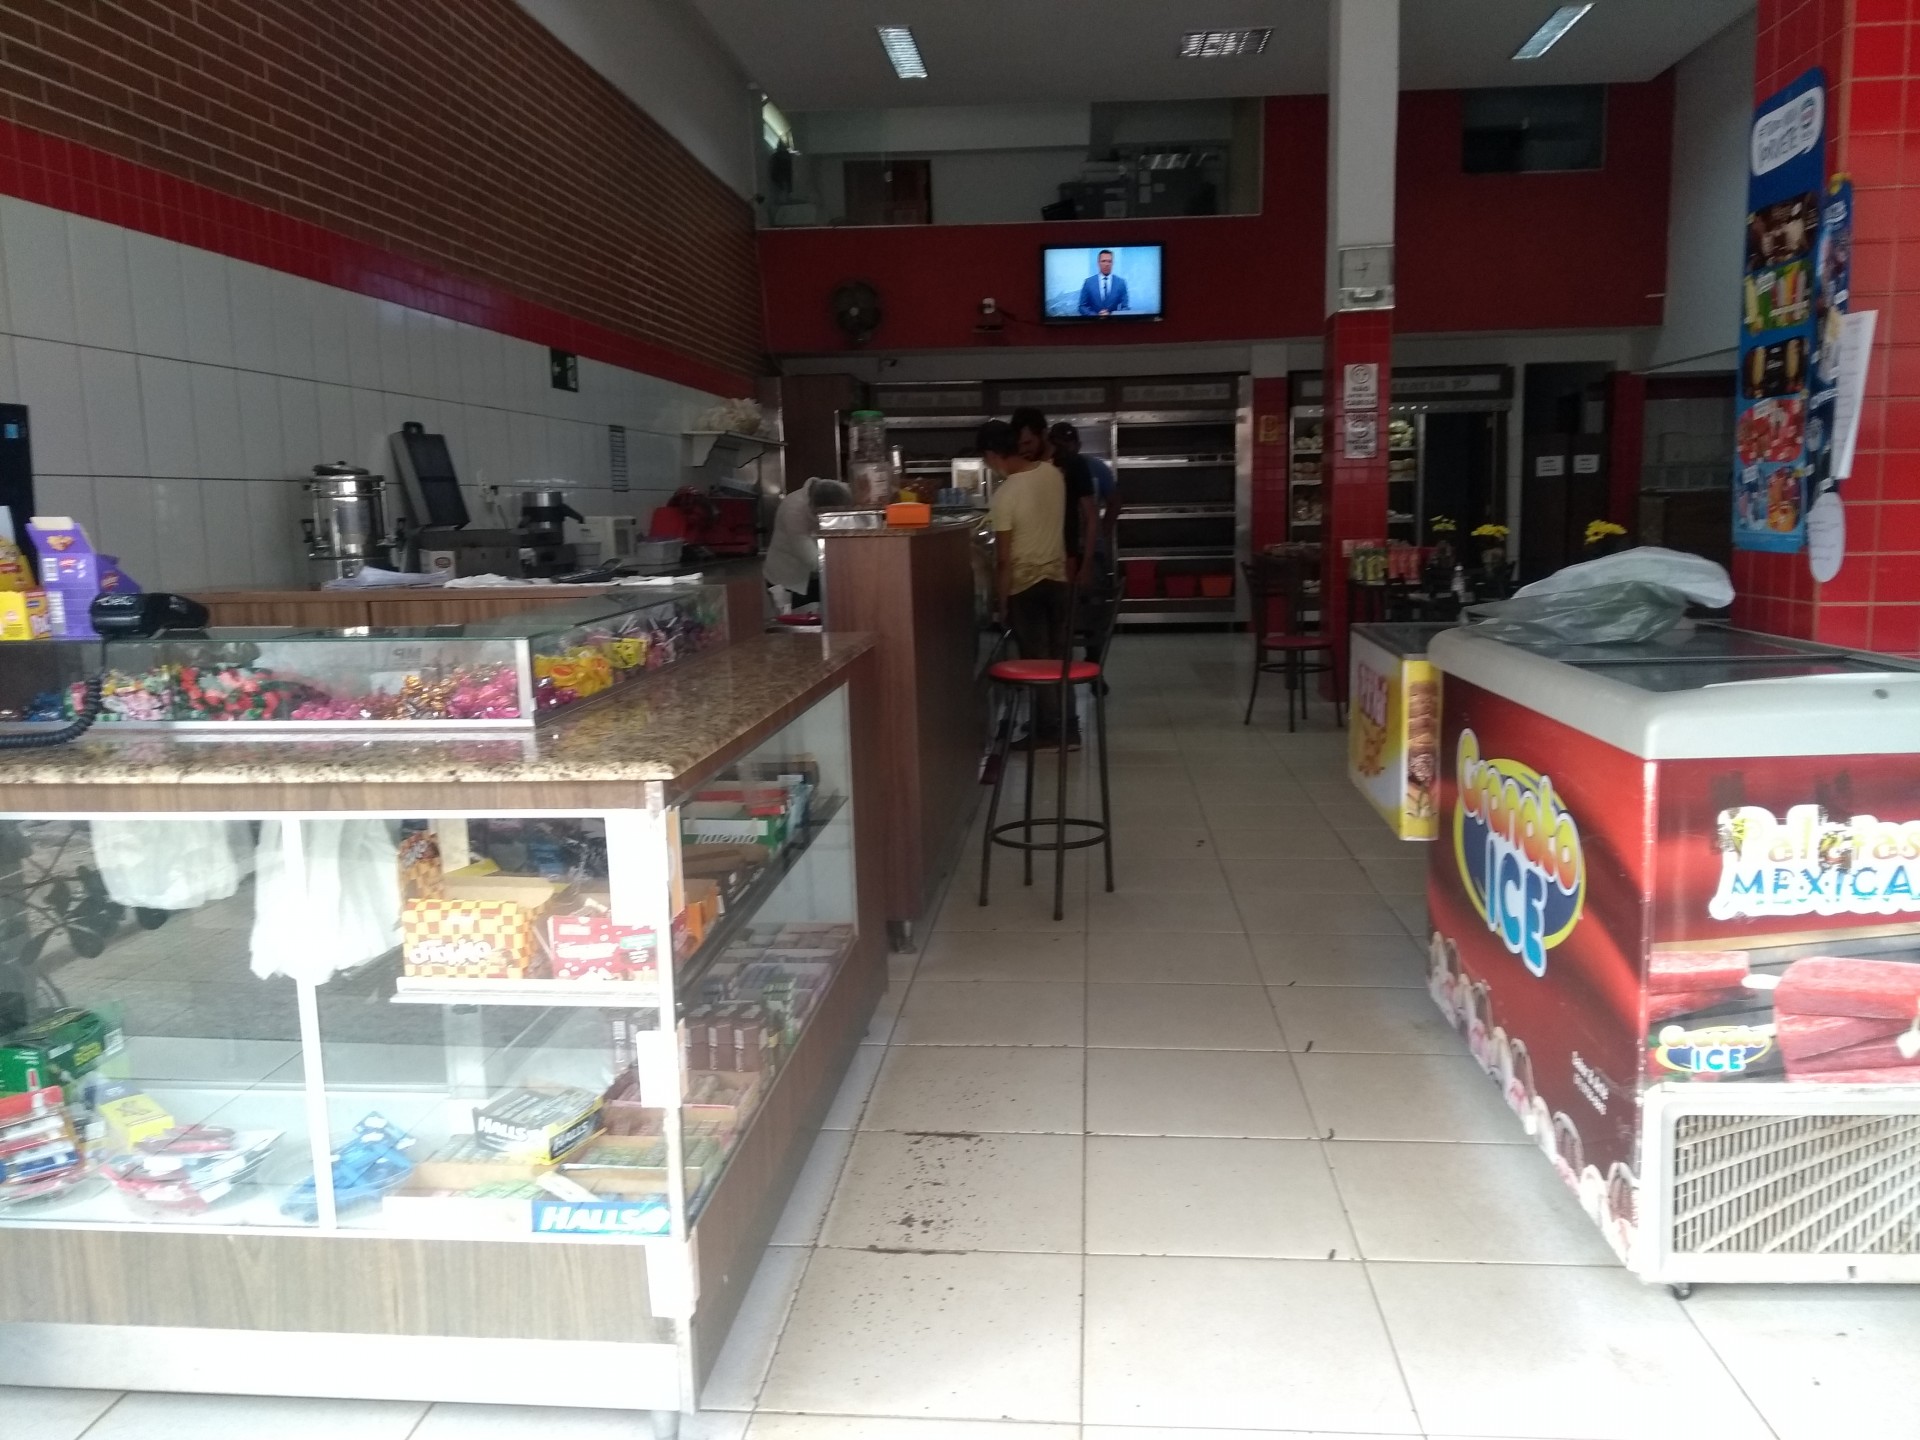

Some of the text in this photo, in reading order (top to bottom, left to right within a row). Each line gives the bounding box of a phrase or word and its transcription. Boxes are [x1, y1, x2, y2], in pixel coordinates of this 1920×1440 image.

[1731, 864, 1920, 896] MEXICA
[1487, 834, 1546, 976] ICE
[1692, 1047, 1745, 1071] ICE
[478, 1115, 528, 1141] HALLS
[540, 1206, 639, 1231] HALLS
